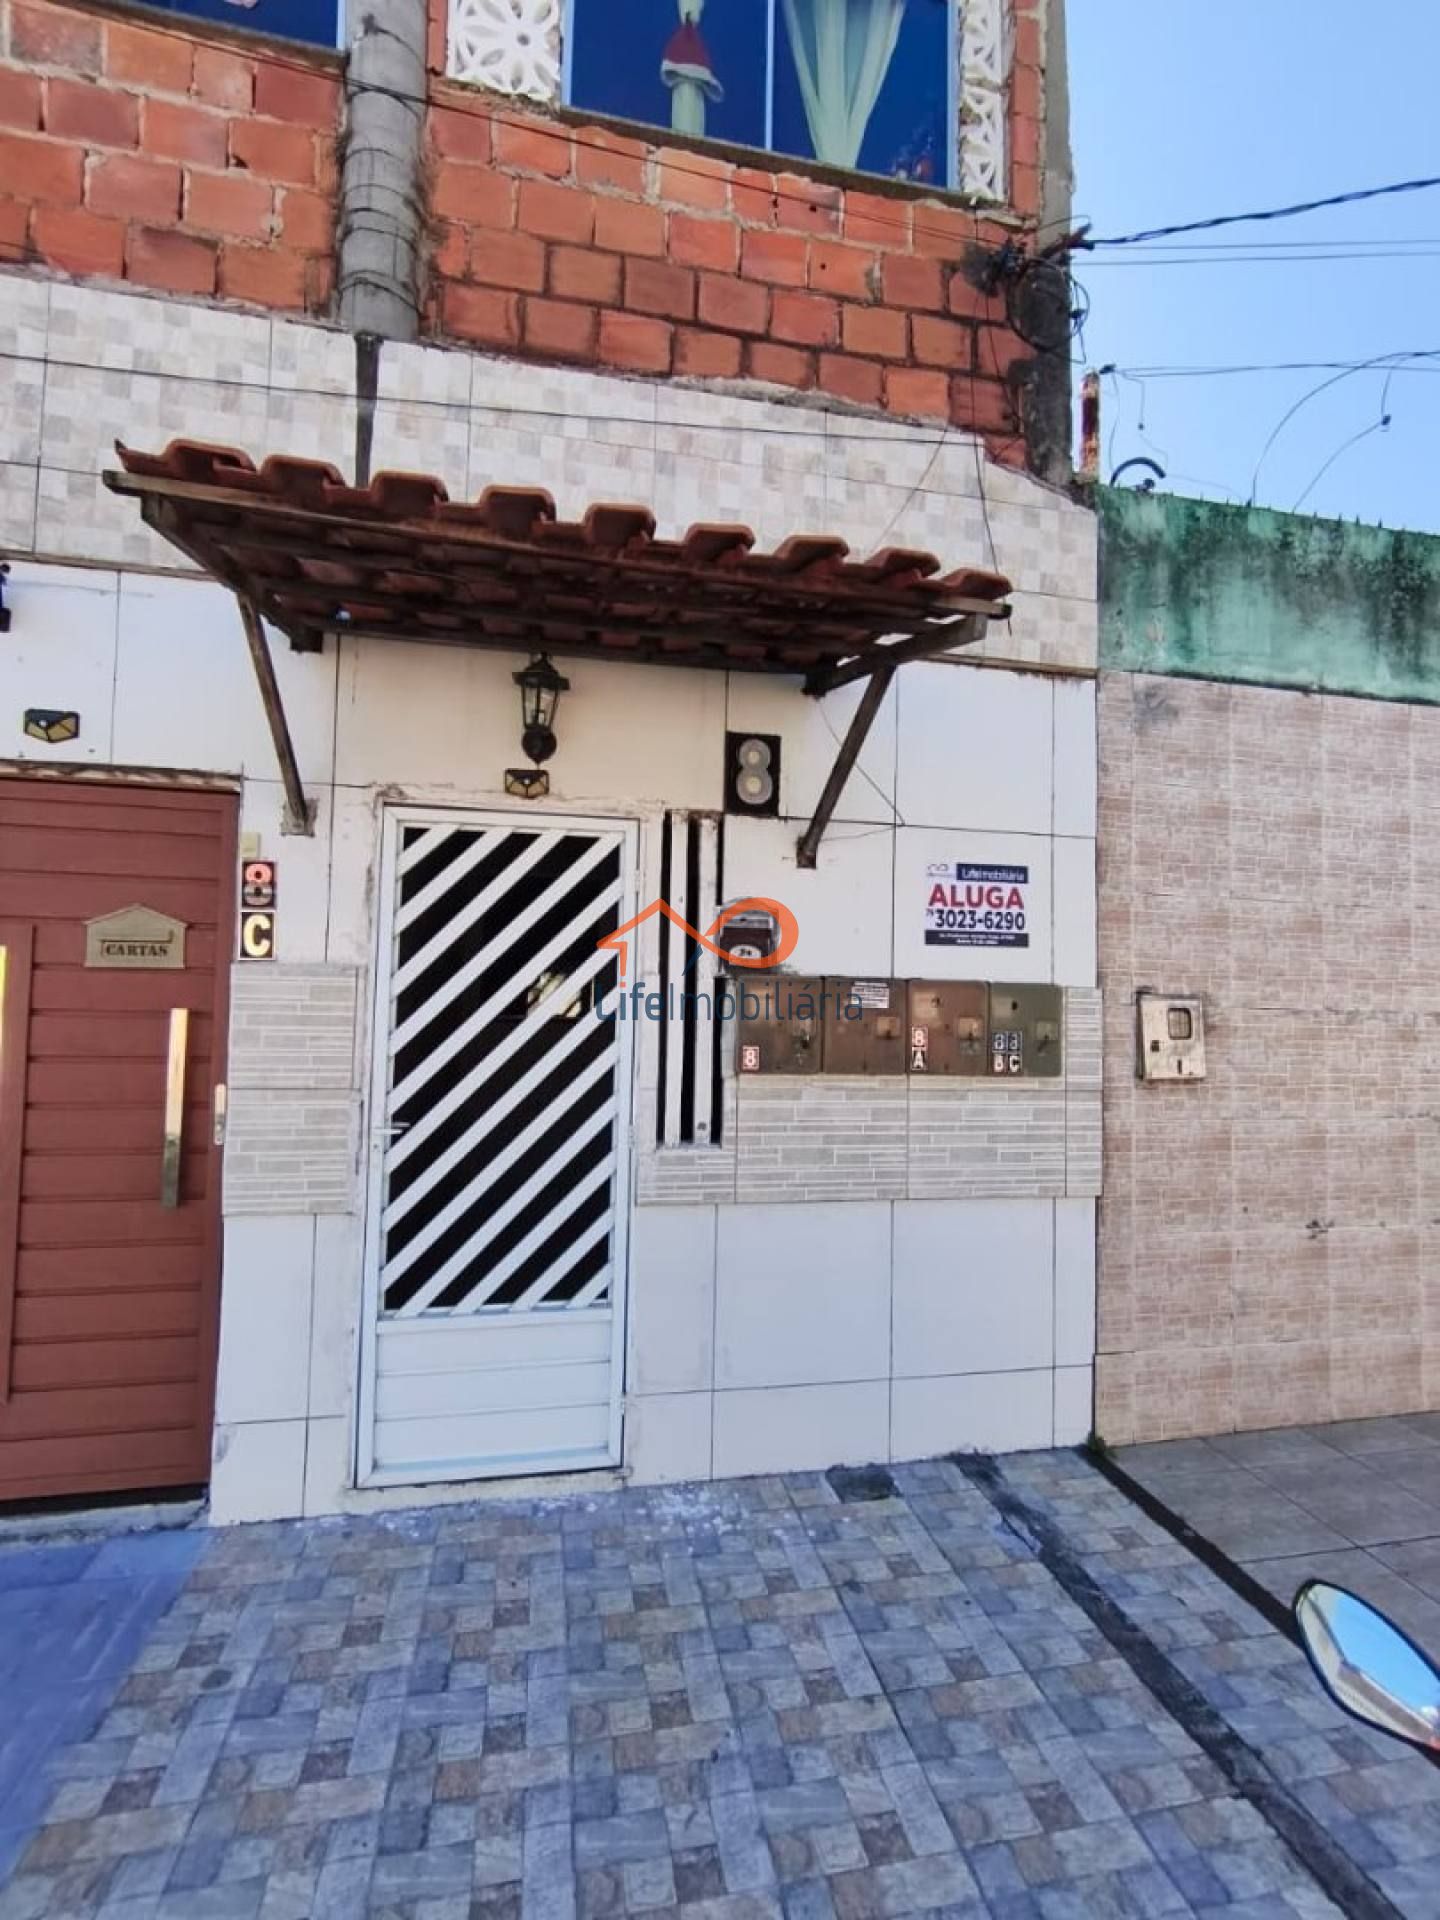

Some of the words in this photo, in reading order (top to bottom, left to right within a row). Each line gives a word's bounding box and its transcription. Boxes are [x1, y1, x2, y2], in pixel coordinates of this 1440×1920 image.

[736, 739, 773, 804] 8
[244, 863, 273, 906] 8
[928, 883, 1025, 909] ALUGA
[243, 914, 270, 957] C
[935, 909, 1025, 930] 3023-6290
[105, 943, 168, 957] CARTAS
